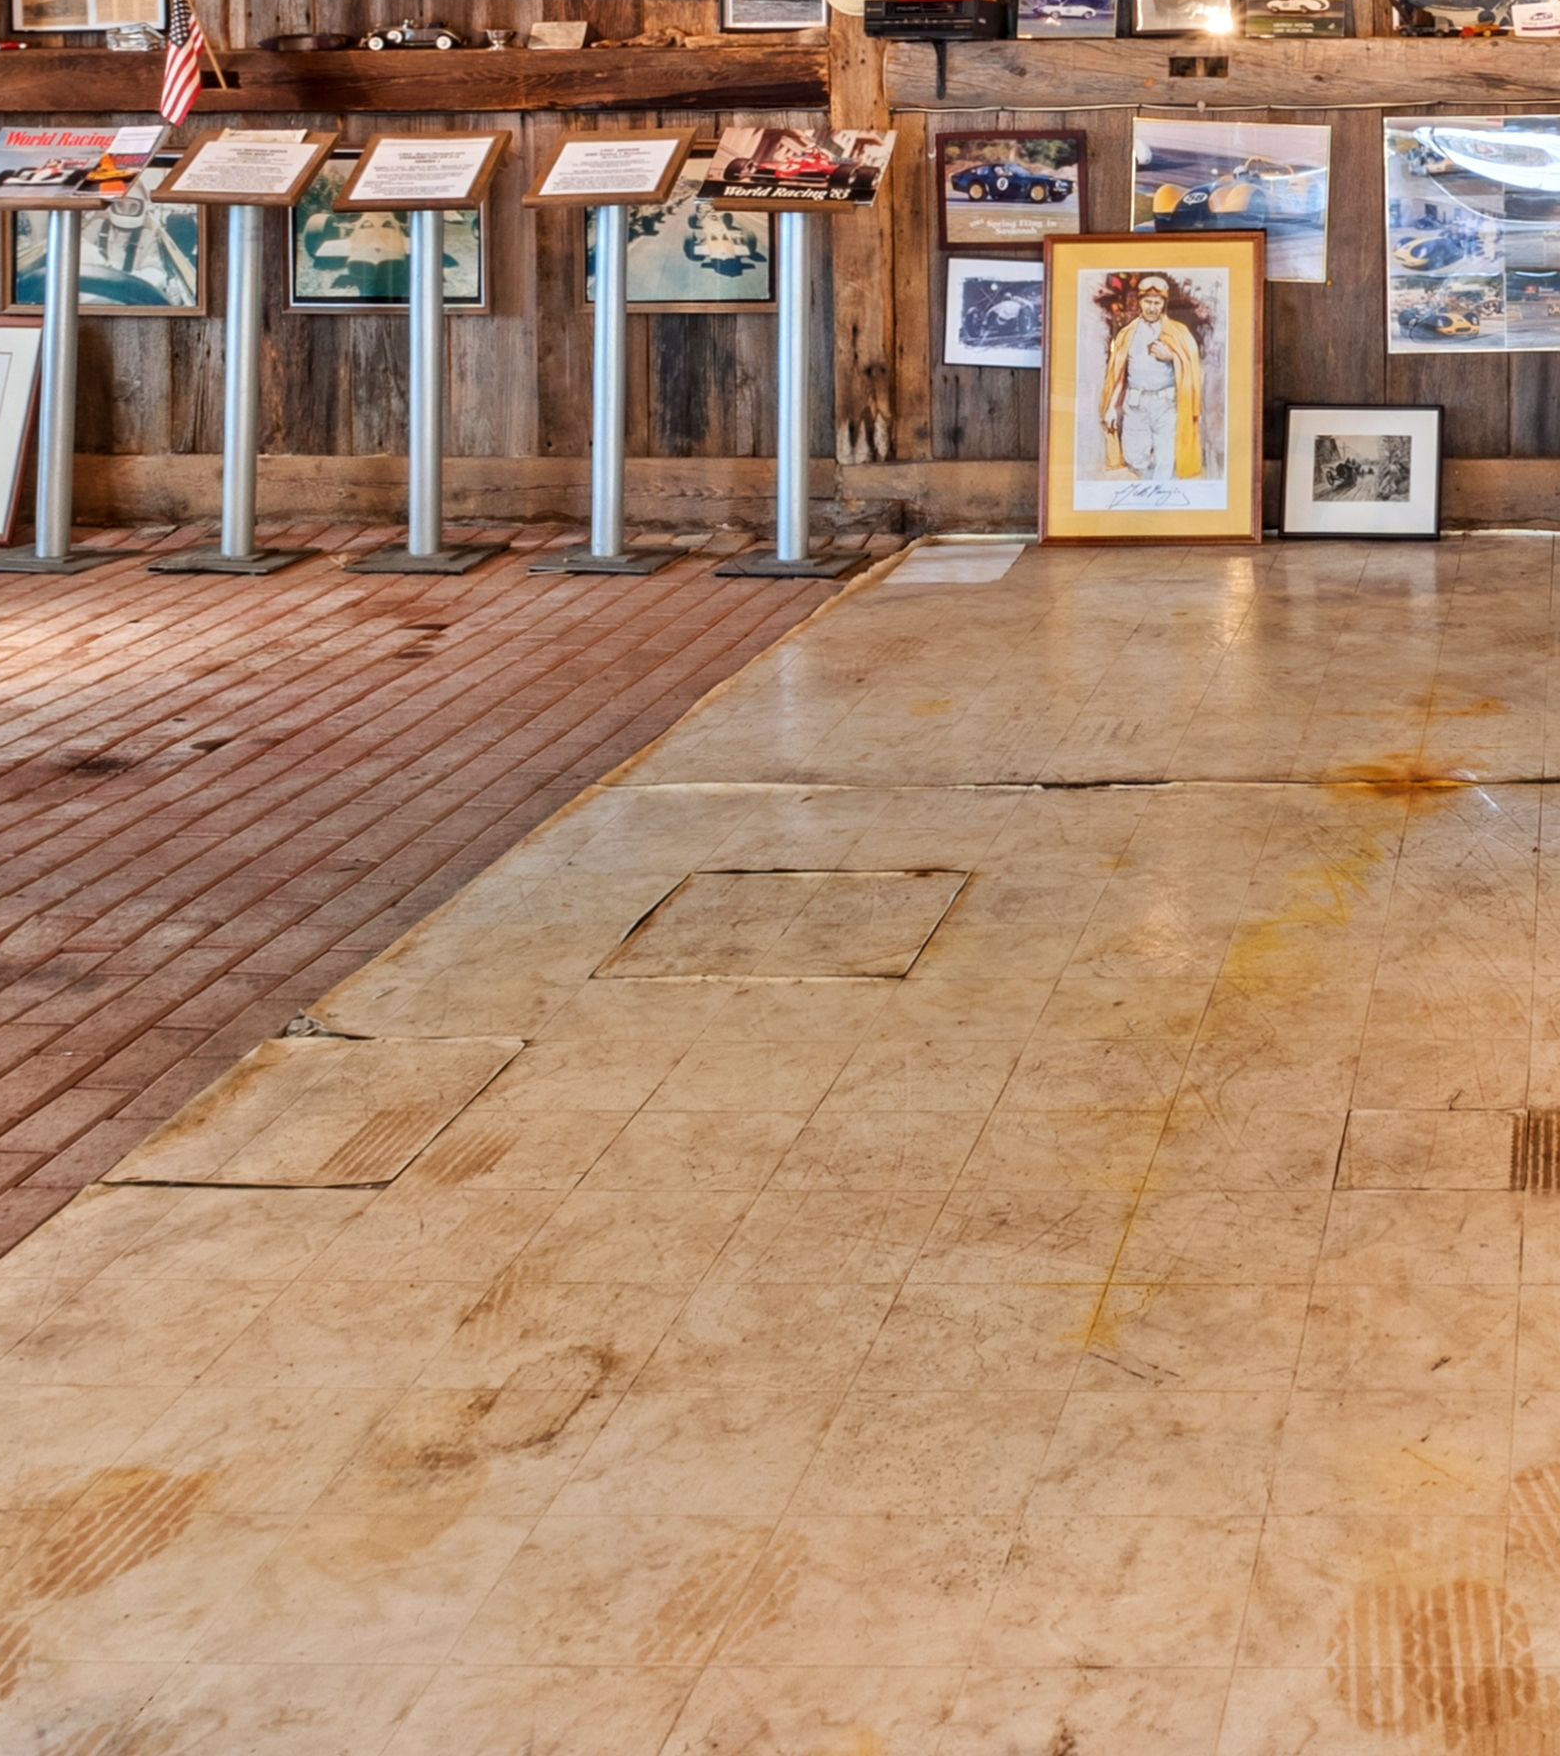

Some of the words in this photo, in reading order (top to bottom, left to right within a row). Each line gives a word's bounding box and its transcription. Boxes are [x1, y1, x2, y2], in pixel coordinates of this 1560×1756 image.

[4, 131, 57, 147] World
[56, 130, 116, 149] Racing
[723, 185, 771, 198] World
[771, 186, 827, 201] Racing
